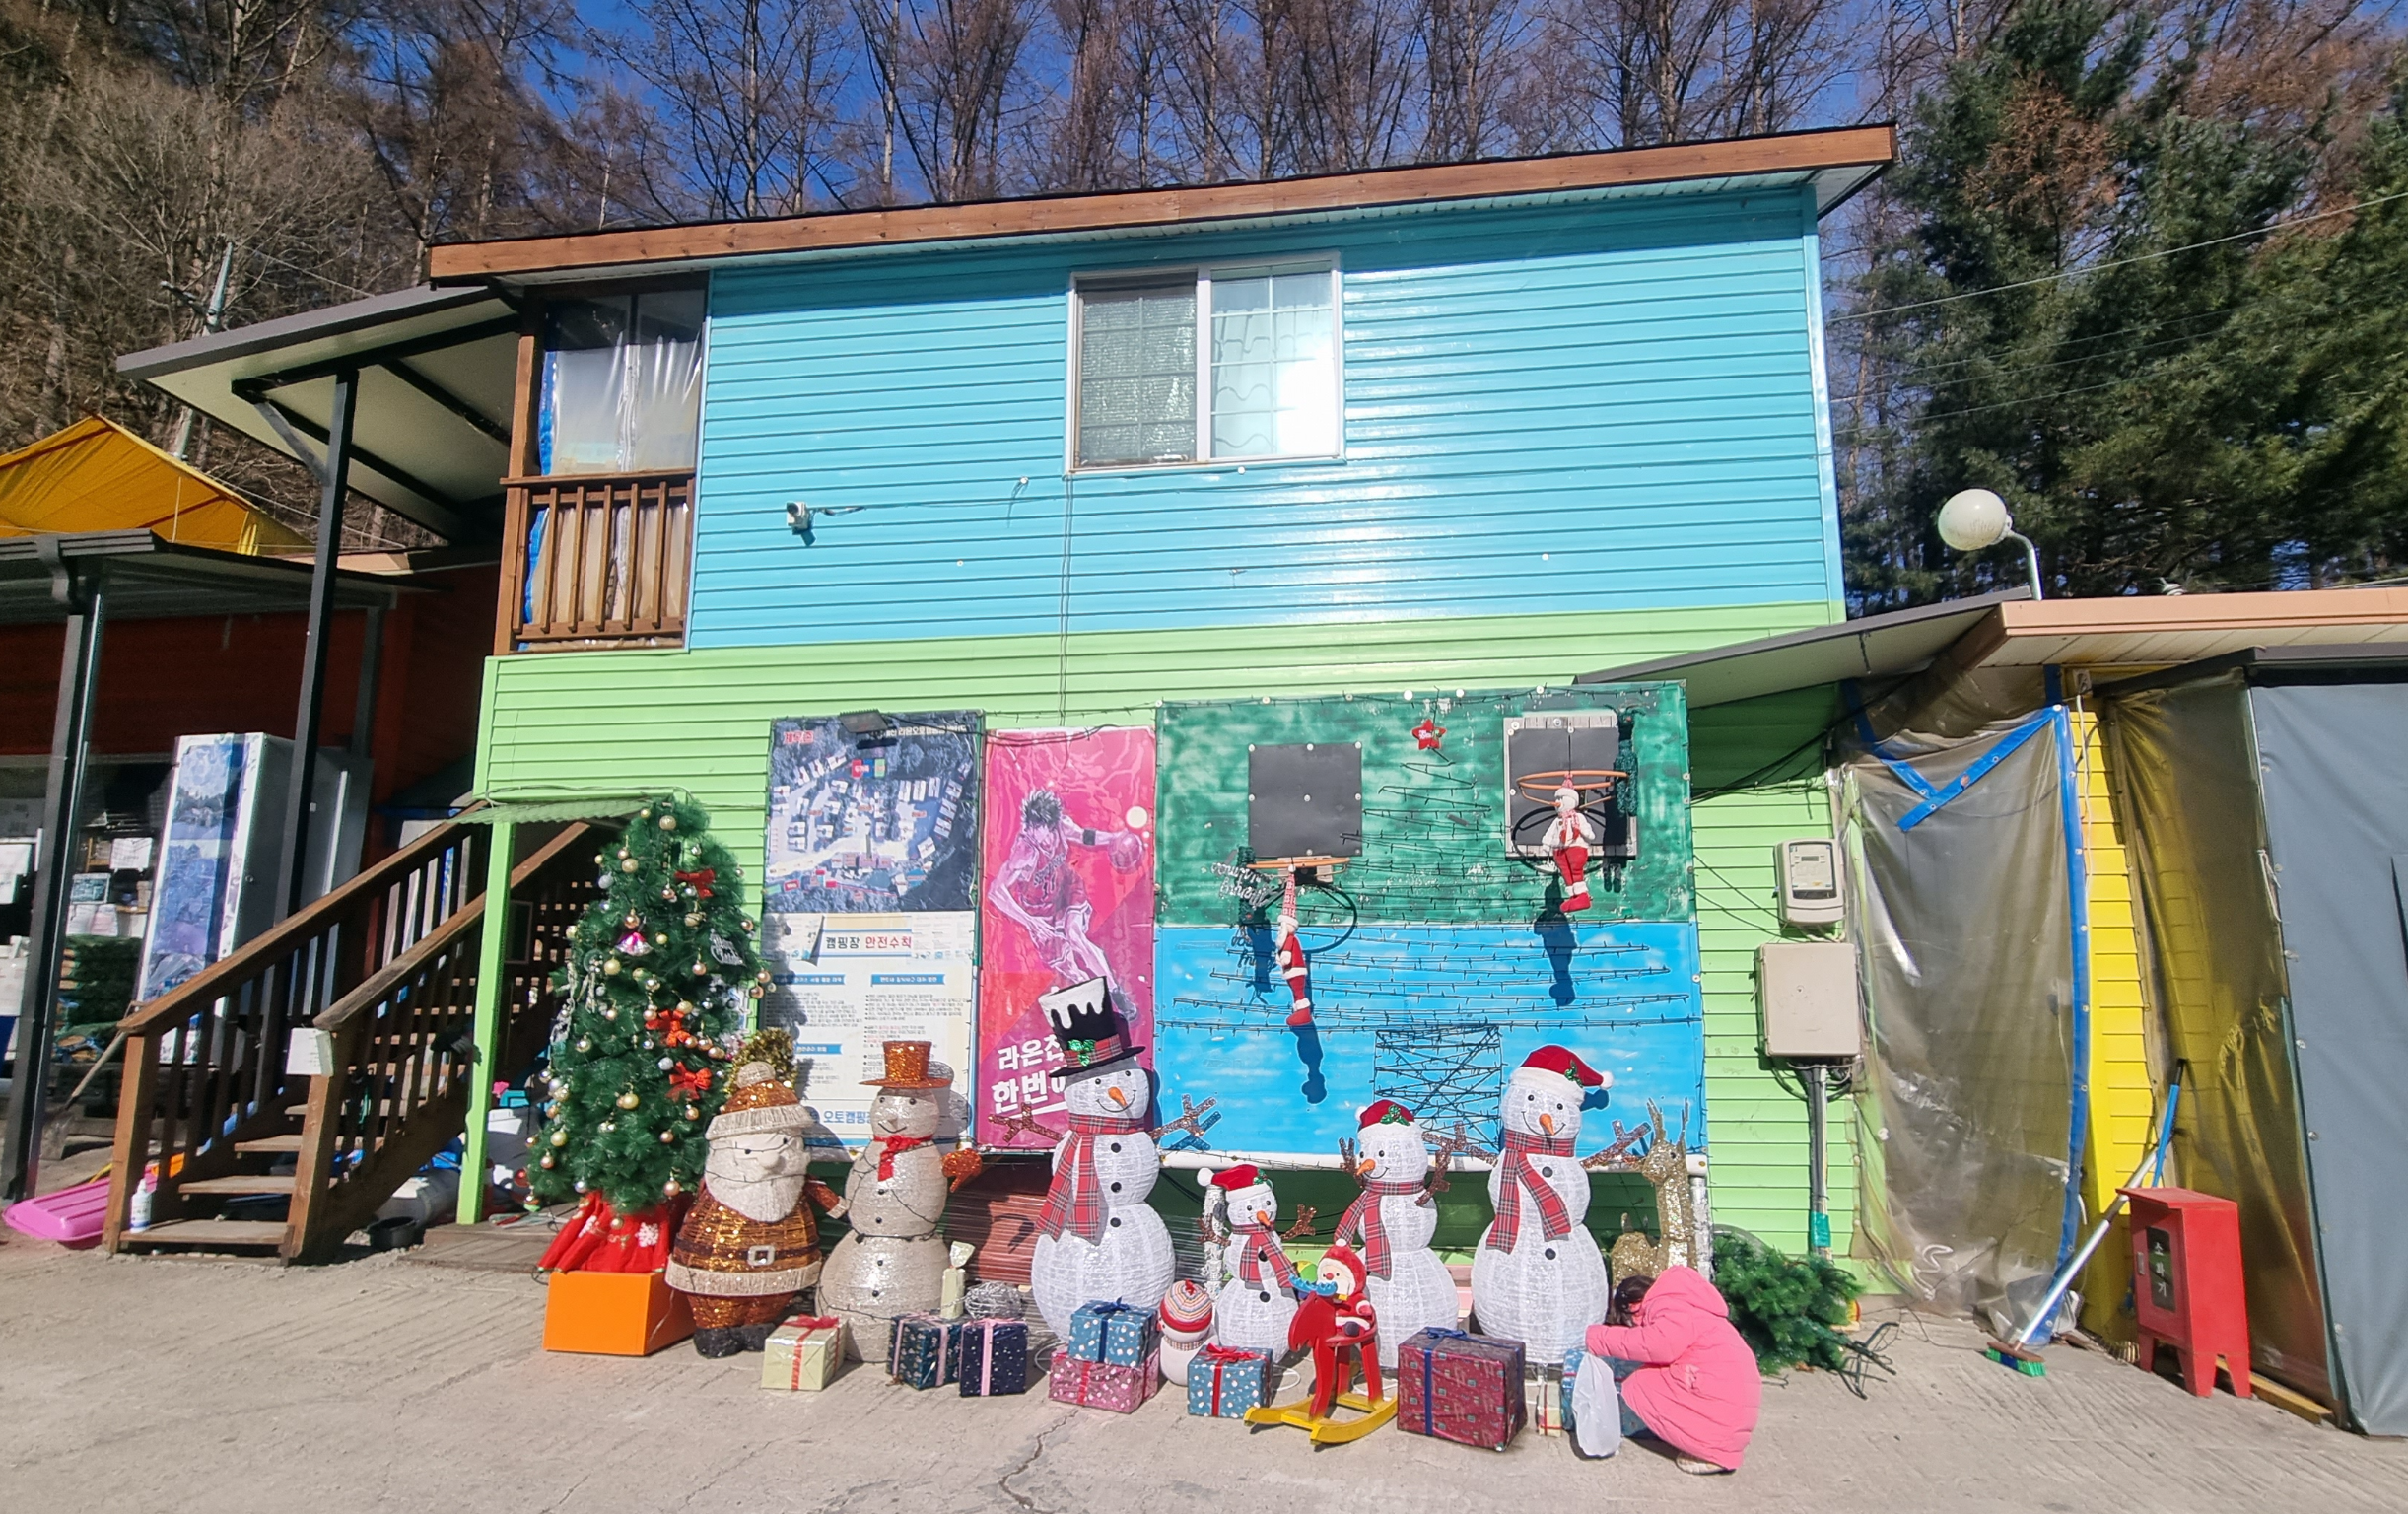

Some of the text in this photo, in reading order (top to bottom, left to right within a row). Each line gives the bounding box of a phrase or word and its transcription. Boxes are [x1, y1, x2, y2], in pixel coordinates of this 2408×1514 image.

[826, 935, 912, 949] 캠핑장 안전수칙
[2155, 1242, 2167, 1297] 소화기
